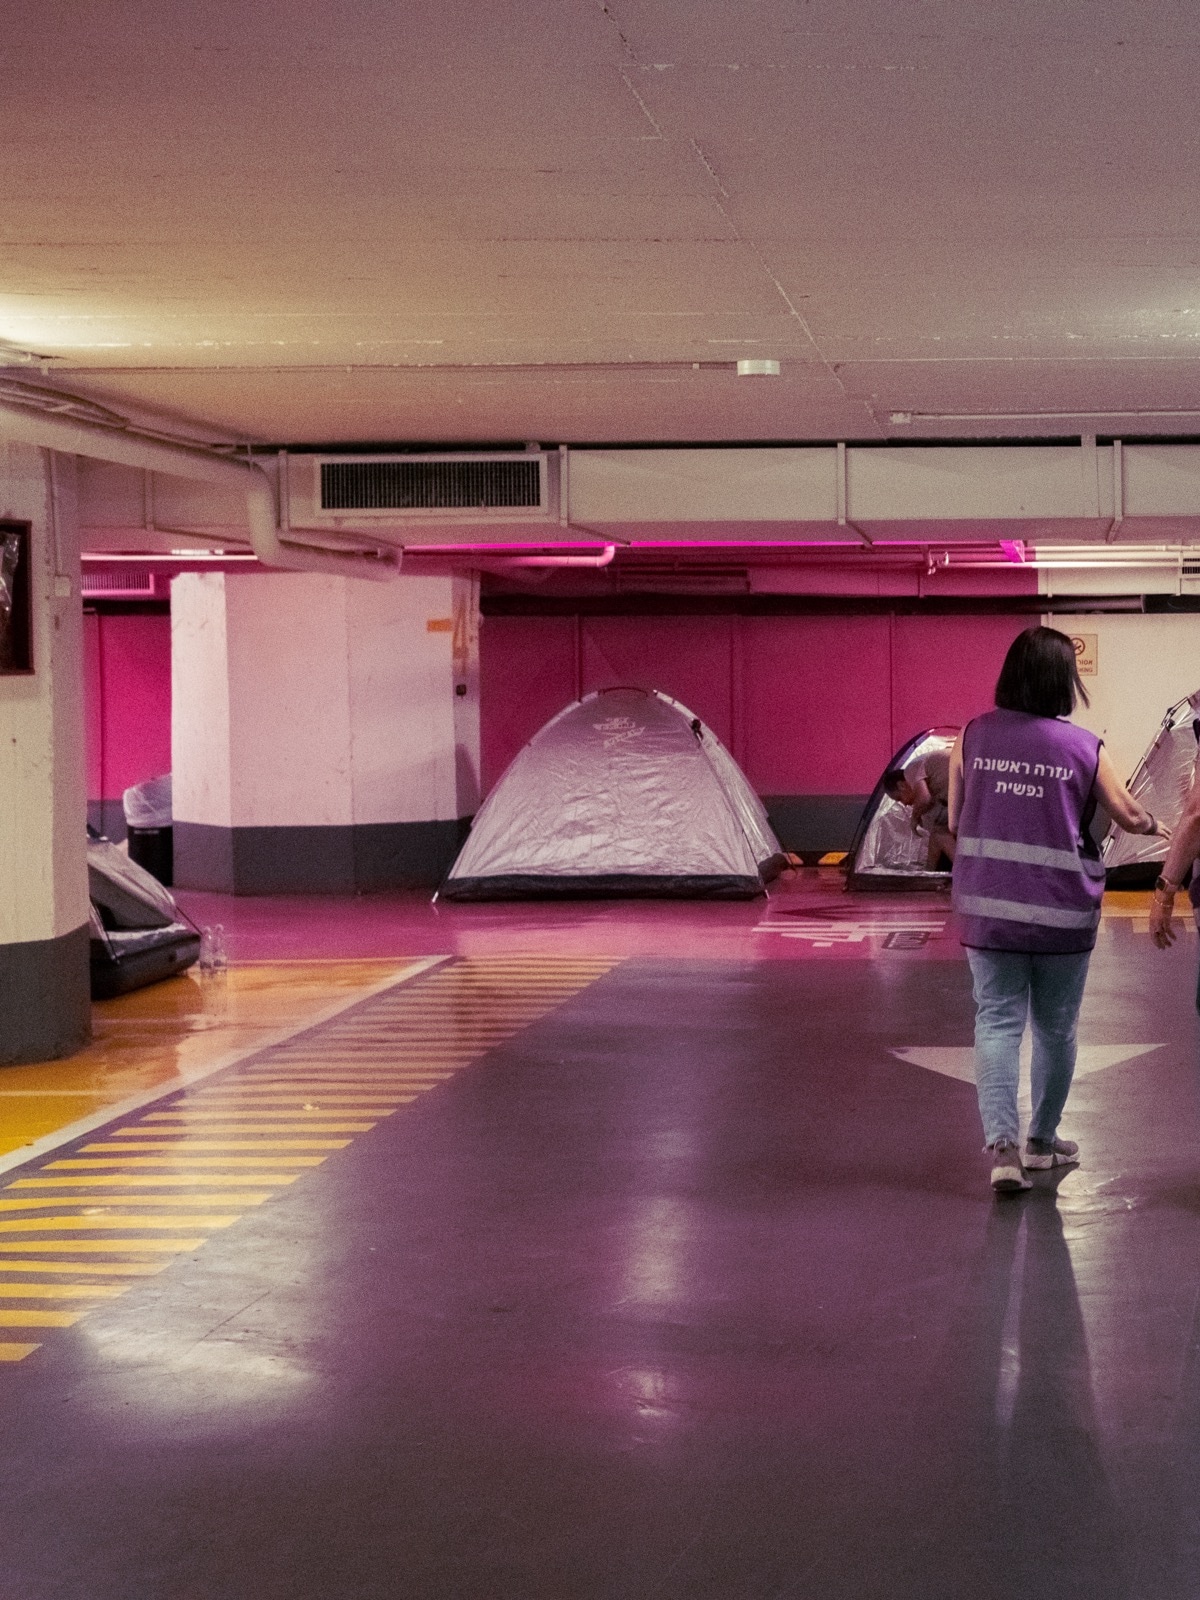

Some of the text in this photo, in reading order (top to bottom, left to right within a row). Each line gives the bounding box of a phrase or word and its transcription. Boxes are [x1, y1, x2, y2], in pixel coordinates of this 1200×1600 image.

[973, 757, 1074, 781] עזרה ראשונה
[994, 781, 1044, 798] נפשית
